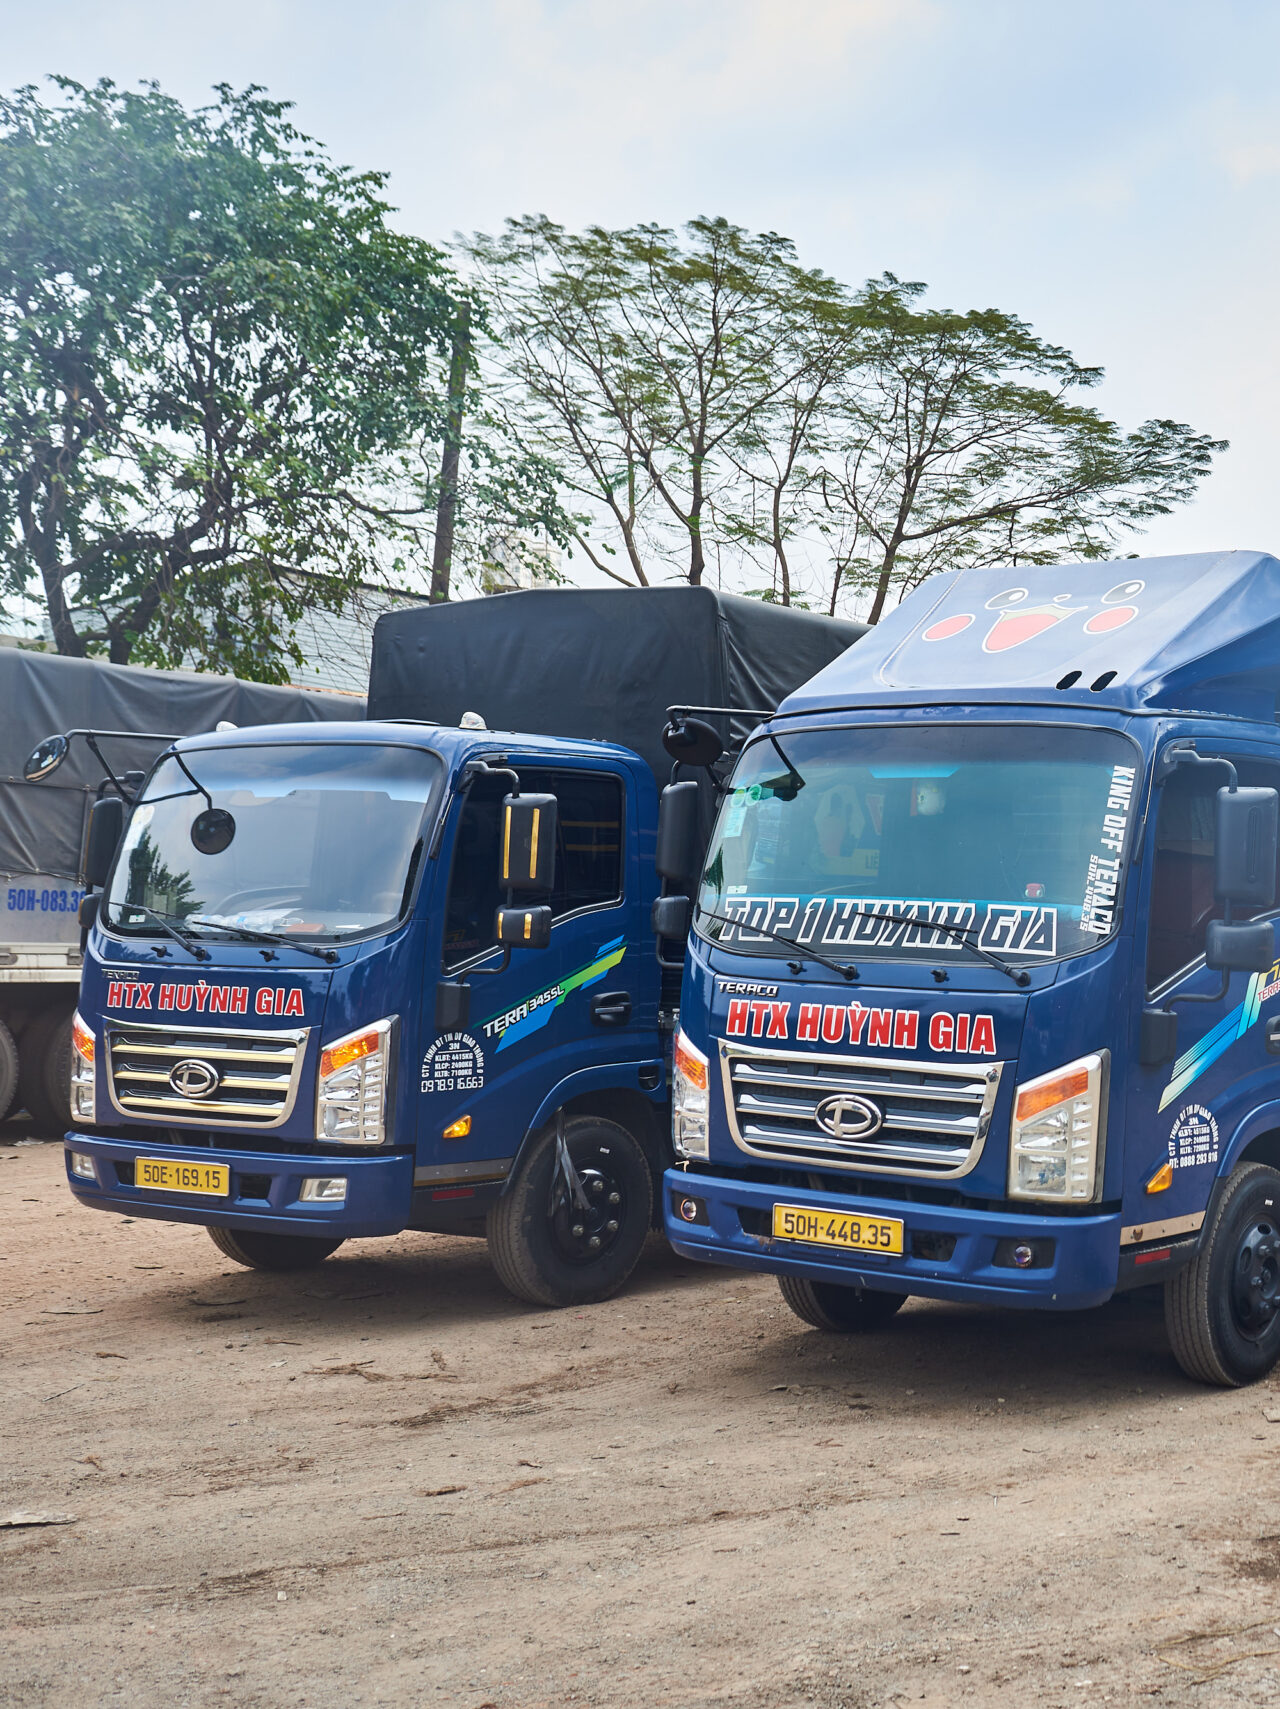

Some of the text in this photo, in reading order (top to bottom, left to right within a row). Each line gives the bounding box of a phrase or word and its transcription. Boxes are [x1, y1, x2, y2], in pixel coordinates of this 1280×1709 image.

[1088, 765, 1136, 935] KING OFF TERACO
[977, 903, 1057, 957] GIA
[107, 980, 305, 1016] HTX HUỲNH GIA
[717, 981, 778, 997] TERACO
[482, 1003, 528, 1038] TERA
[726, 998, 997, 1056] HTX HUỲNH GIA
[448, 1042, 460, 1050] 3N
[143, 1164, 221, 1189] 50E-169.15
[784, 1212, 892, 1248] 50H-448.35
